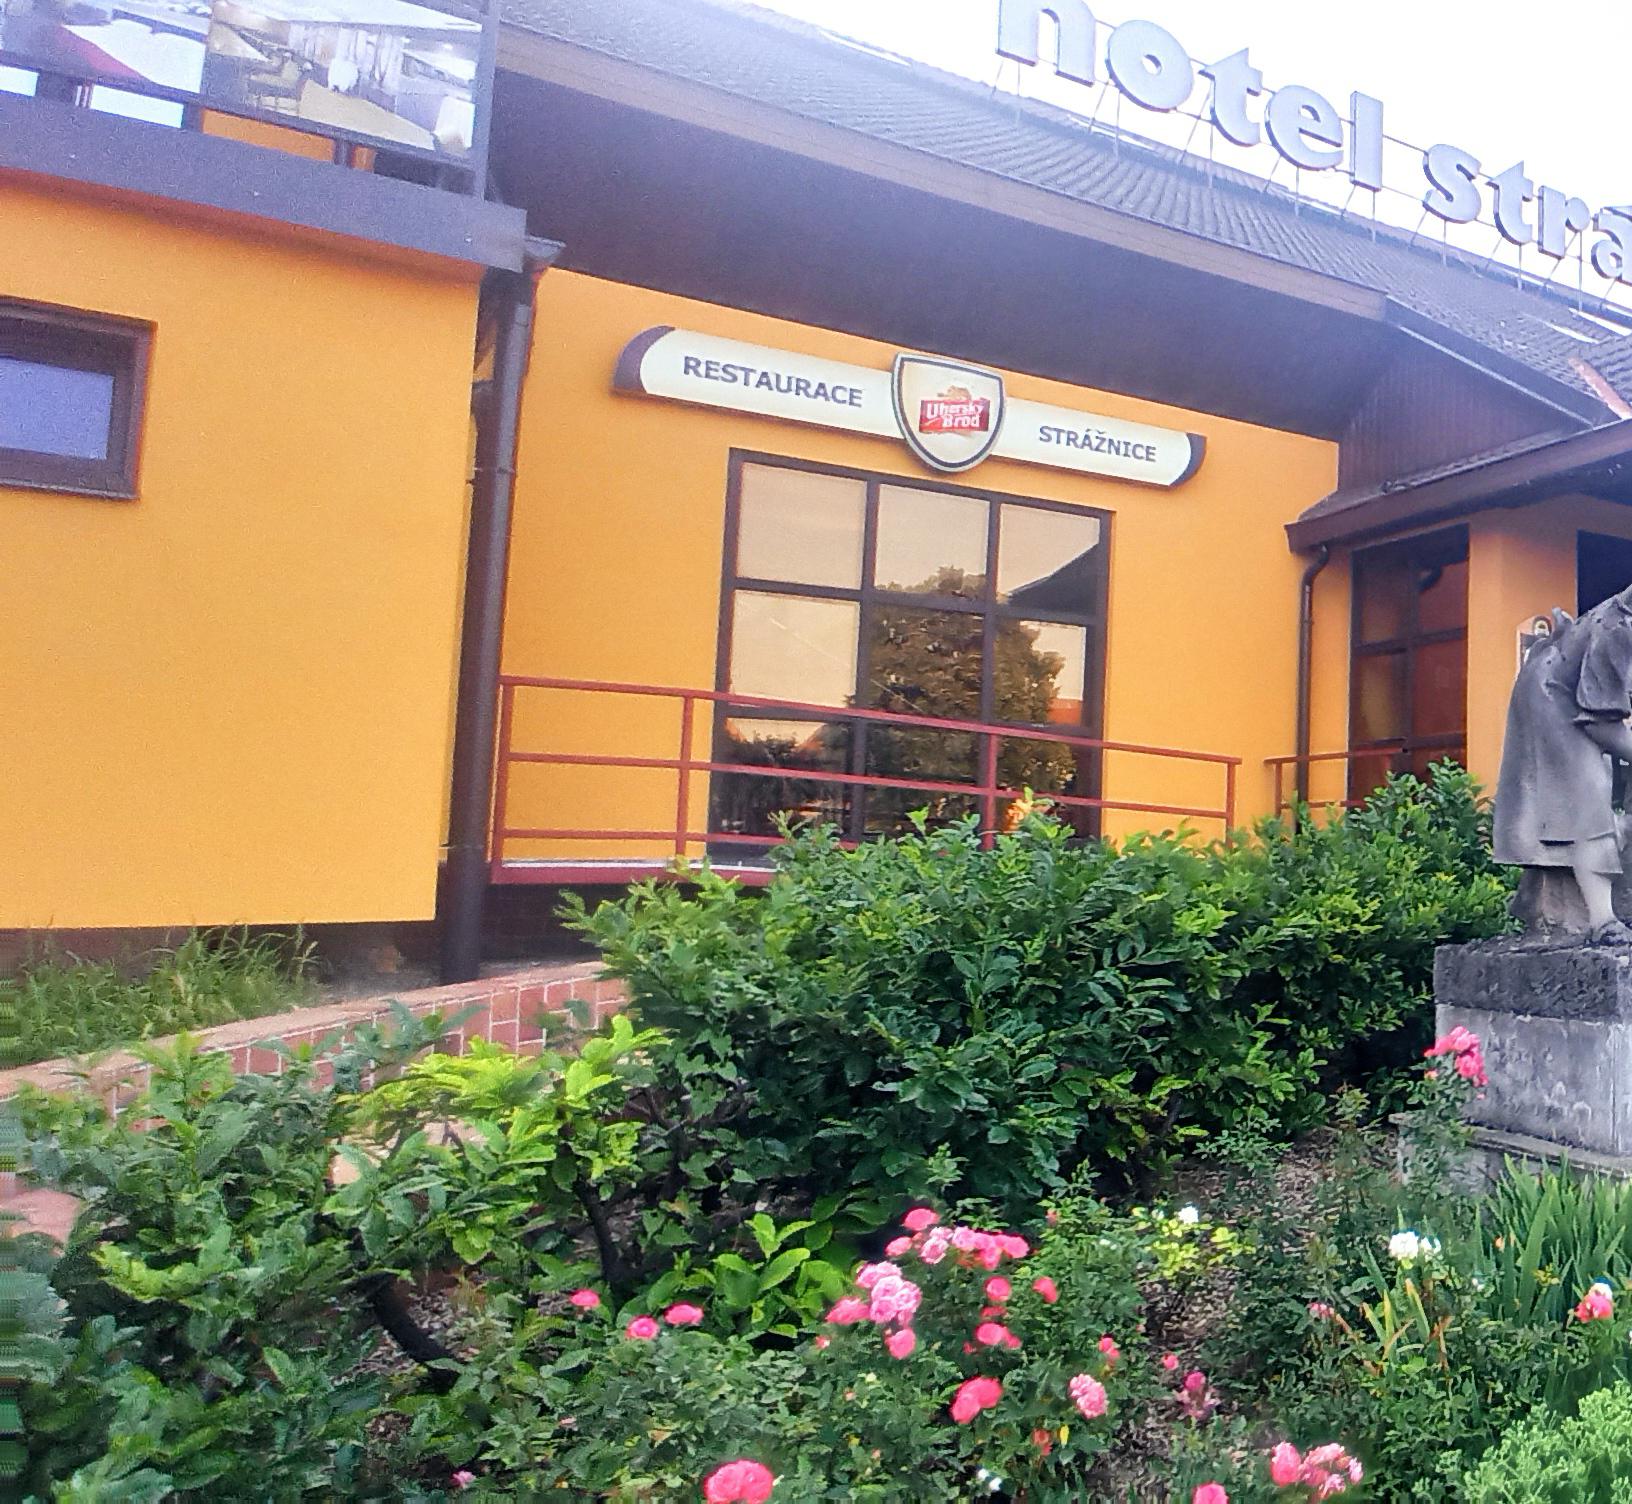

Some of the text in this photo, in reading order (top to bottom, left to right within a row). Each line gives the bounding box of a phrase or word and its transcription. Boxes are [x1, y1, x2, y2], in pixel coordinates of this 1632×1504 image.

[684, 356, 863, 408] RESTAURACE
[942, 413, 981, 428] Brod
[1039, 426, 1157, 462] STRÁŽNICE
